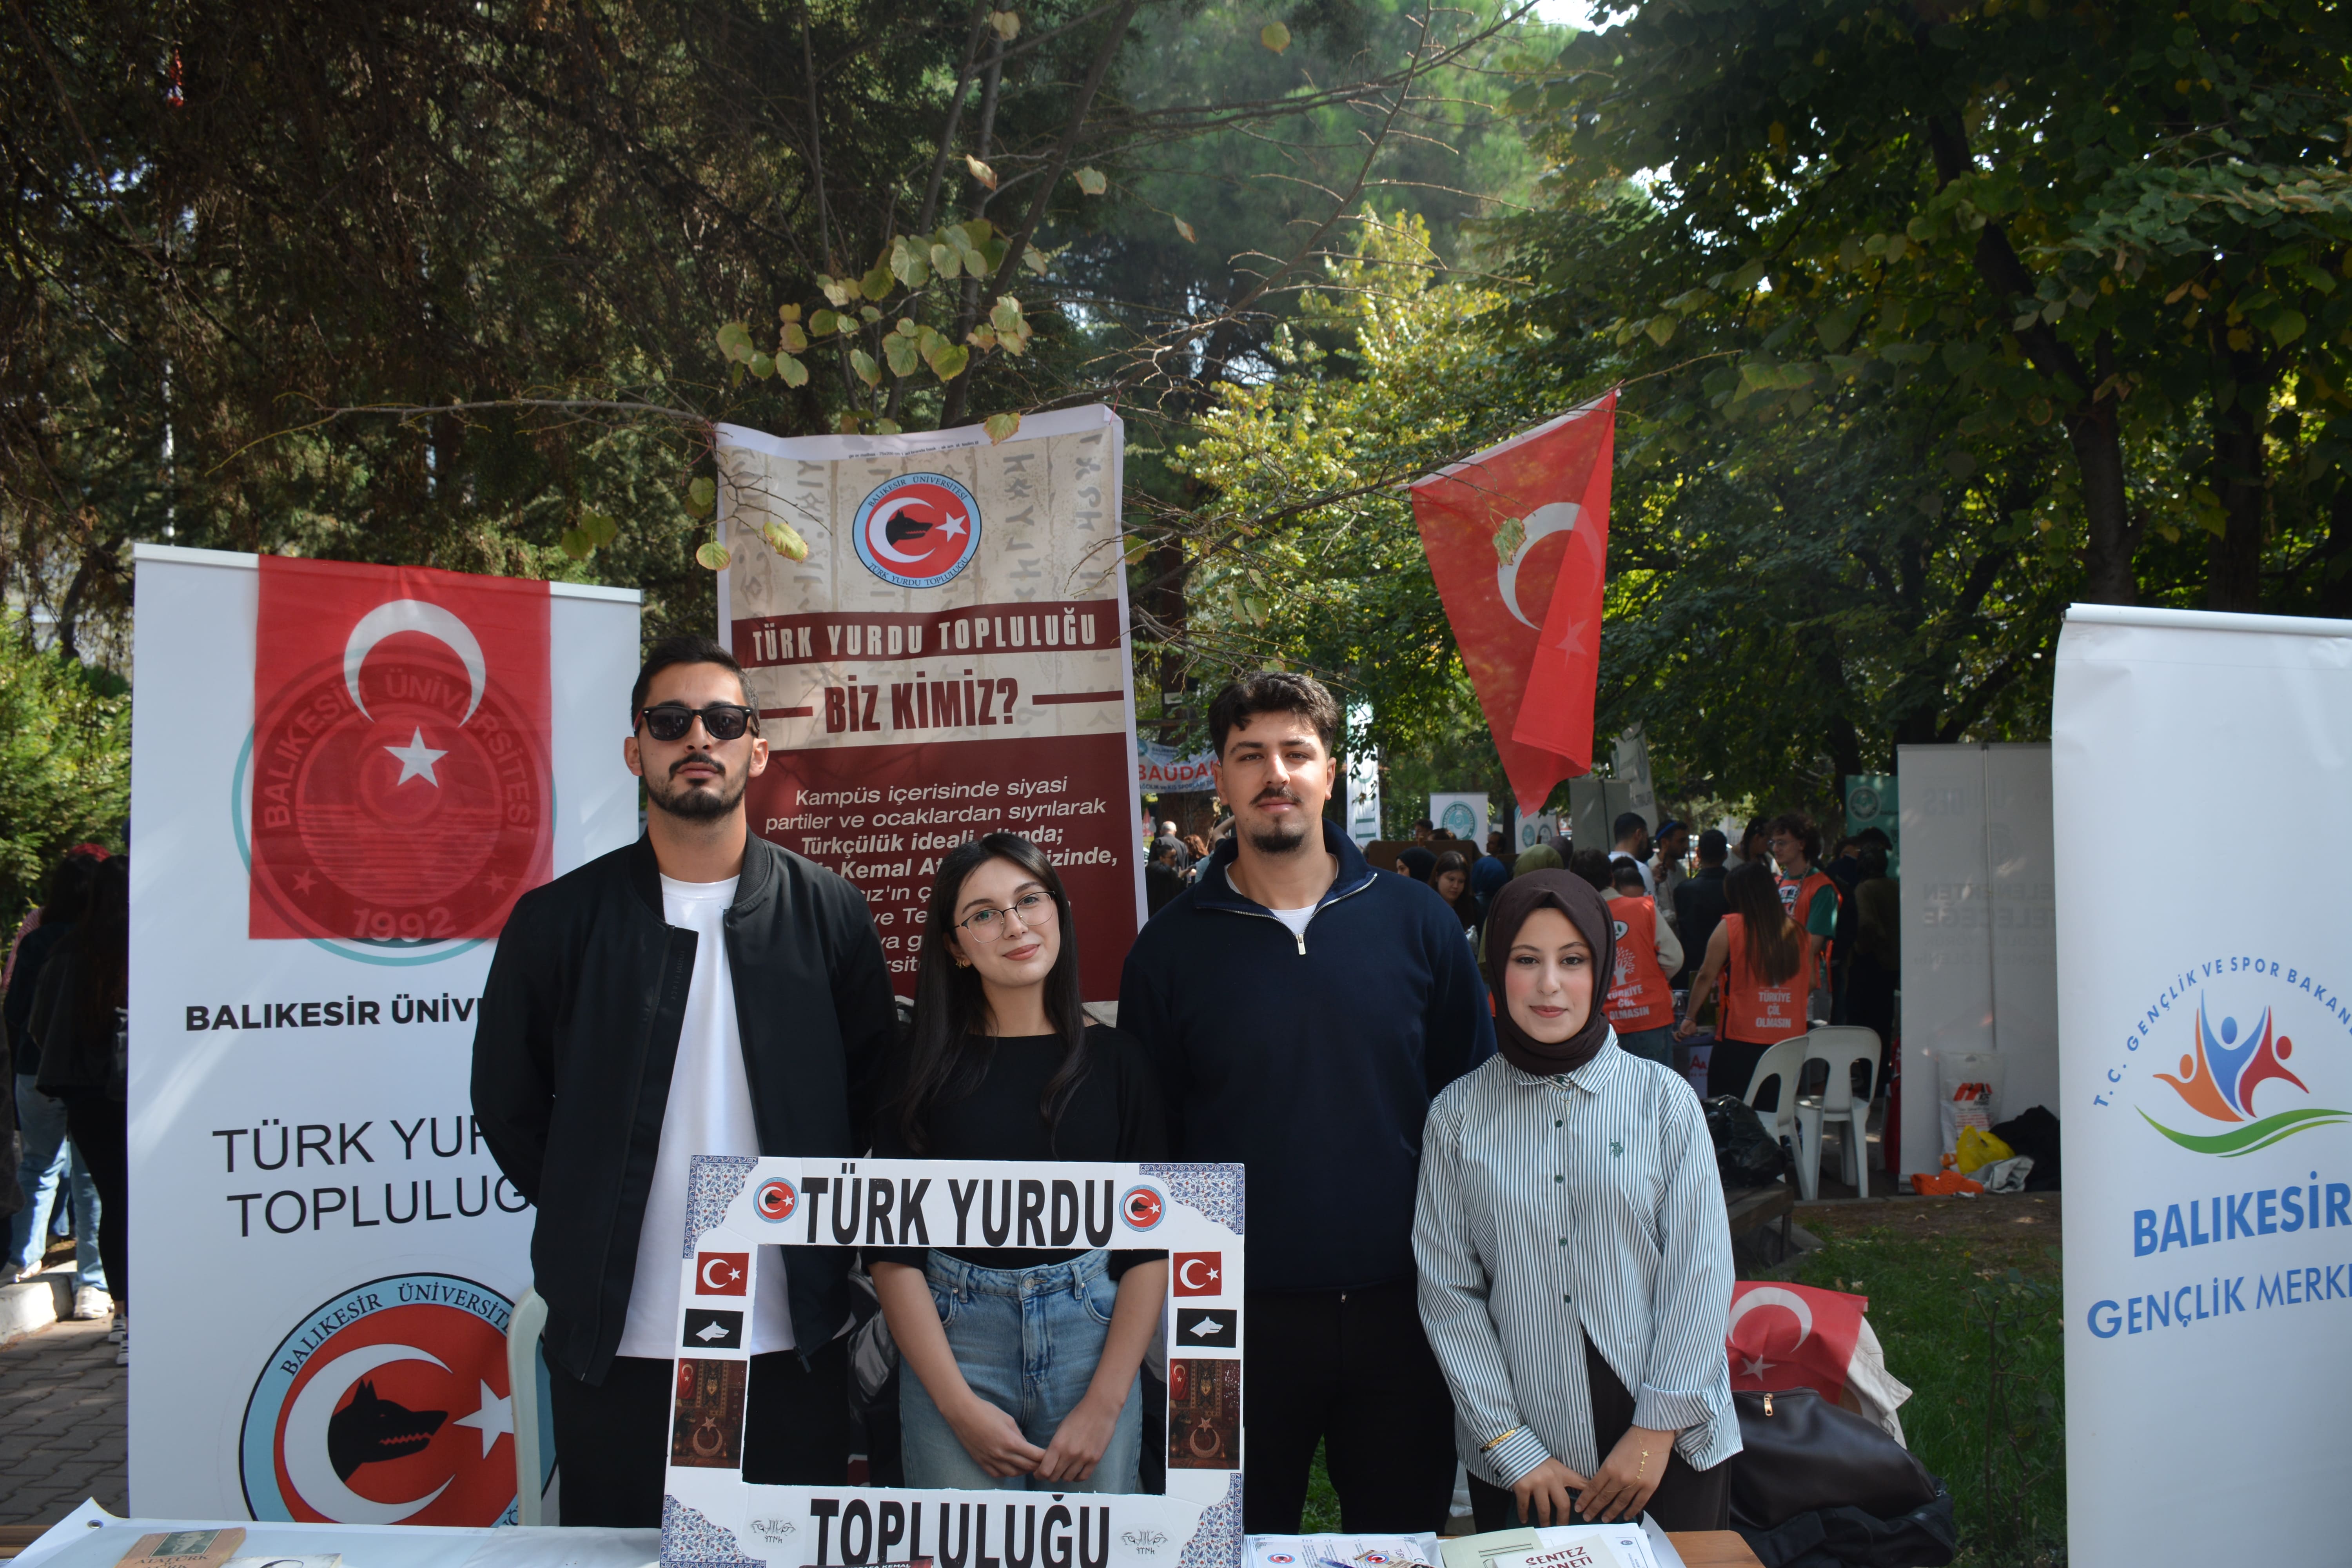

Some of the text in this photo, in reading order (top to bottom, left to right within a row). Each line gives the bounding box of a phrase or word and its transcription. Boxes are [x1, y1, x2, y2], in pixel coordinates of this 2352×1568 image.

[867, 476, 968, 507] BALIKESİR ÜNİVERSİTESİ
[869, 557, 969, 586] TÜRK YURDU TOPLULUĞU
[753, 607, 1096, 662] TÜRK YURDU TOPLULUĞU
[825, 668, 1019, 733] BİZ KİMİZ?
[263, 667, 536, 835] BALIKESİR ÜNİVERSİTESİ
[796, 776, 1068, 808] Kampüs içerisinde siyasi
[765, 798, 1107, 834] partiler ve ocaklardan sıyrılarak
[802, 834, 904, 858] Türkçülük
[840, 858, 912, 879] Kemal
[351, 907, 457, 943] 1992
[1607, 984, 1643, 1000] TÜRKİYE
[1617, 998, 1636, 1009] ÇÖL
[1759, 989, 1791, 1003] TÜRKİYE
[1767, 1003, 1781, 1017] ÇÖL
[2127, 970, 2197, 1052] GENÇLİK
[2202, 959, 2223, 978] VE
[2230, 957, 2279, 977] SPOR
[2287, 969, 2352, 1036] BAKAN
[185, 995, 380, 1032] BALIKESİR
[1609, 1006, 1650, 1020] OLMASIN
[1756, 1017, 1791, 1028] OLMASIN
[212, 1119, 375, 1173] TÜRK
[800, 1163, 1114, 1249] TÜRK YURDU
[2133, 1171, 2352, 1258] BALIKESİR
[2087, 1263, 2352, 1339] GENÇLİK MERK
[280, 1281, 510, 1377] BALIKESİR ÜNİVERSİT
[810, 1494, 1110, 1568] TOPLULUĞU
[1526, 1546, 1586, 1566] SENTEZ
